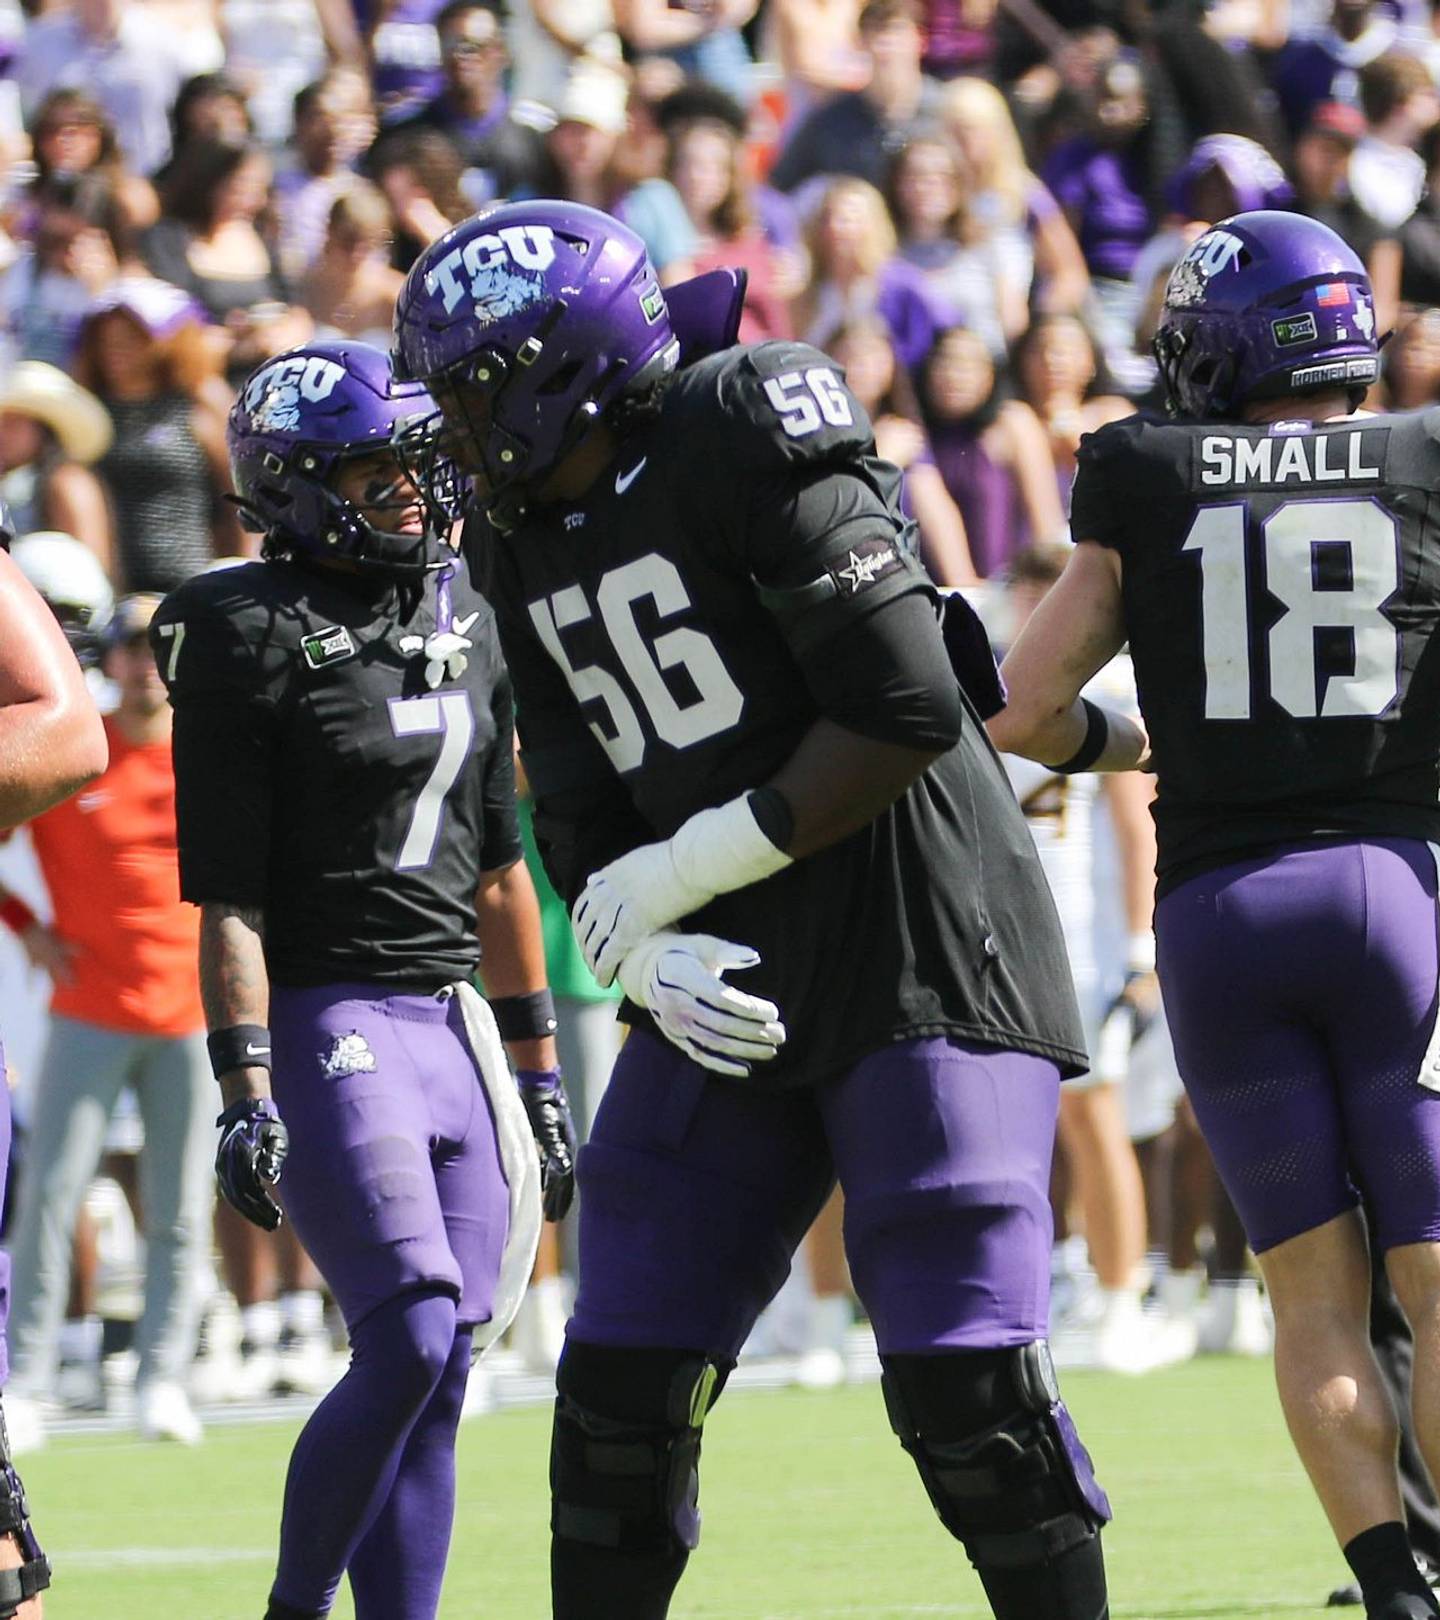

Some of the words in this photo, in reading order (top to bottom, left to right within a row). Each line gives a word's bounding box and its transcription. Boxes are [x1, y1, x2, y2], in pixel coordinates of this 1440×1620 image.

[424, 225, 556, 315] TCU
[1184, 230, 1244, 278] CU
[245, 356, 347, 413] TCU
[763, 368, 853, 437] 56
[1201, 431, 1380, 485] SMALL
[563, 512, 585, 531] TCU
[1180, 499, 1399, 720] 18
[158, 621, 185, 682] 7
[527, 552, 745, 774] 56
[388, 691, 474, 869] 7
